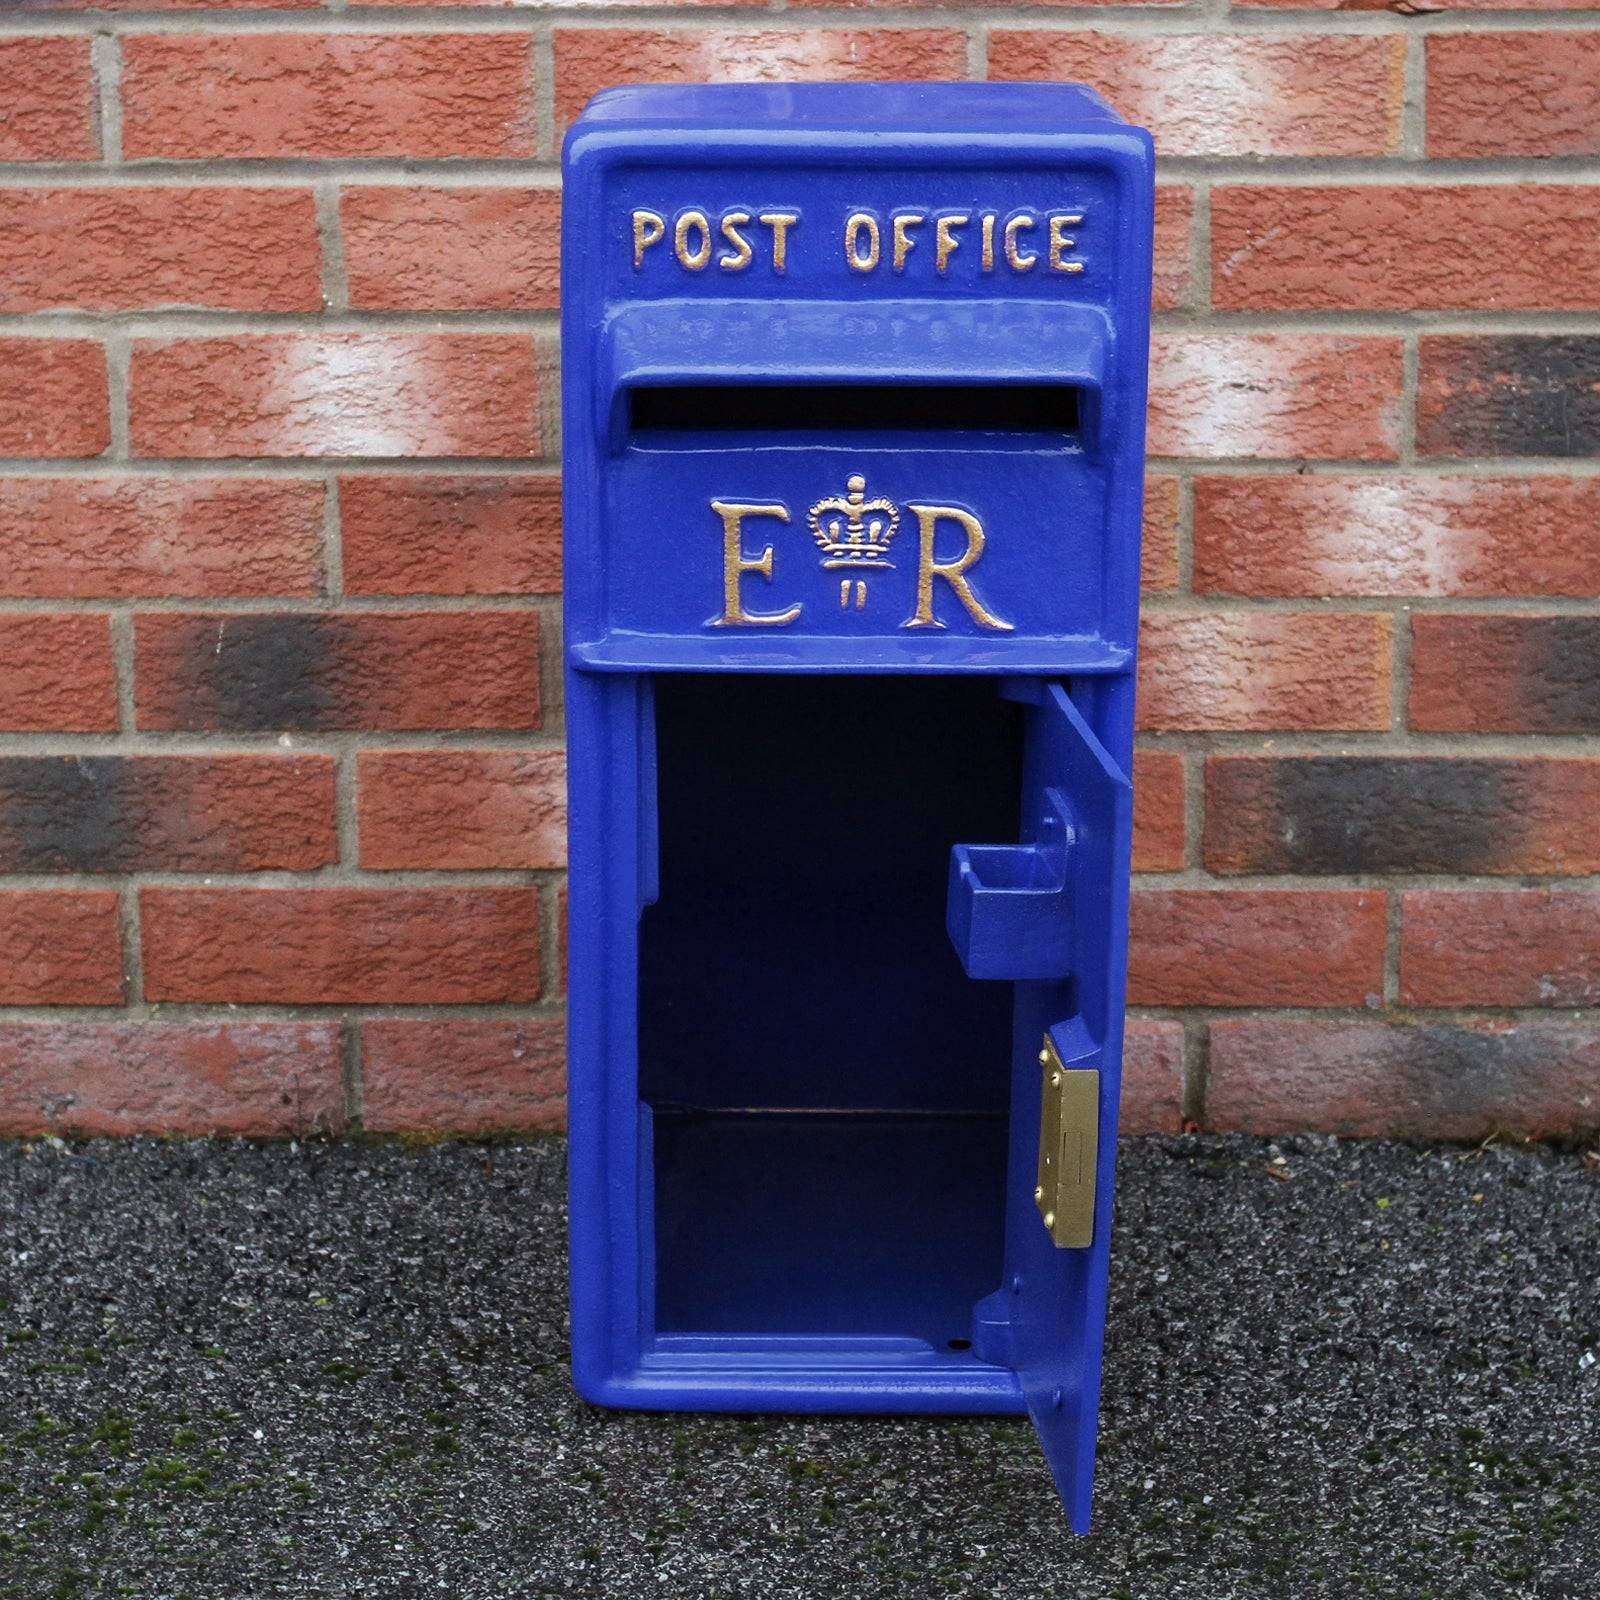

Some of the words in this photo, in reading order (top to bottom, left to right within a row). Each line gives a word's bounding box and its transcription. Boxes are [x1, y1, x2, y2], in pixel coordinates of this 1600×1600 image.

[632, 210, 797, 274] POST
[844, 213, 1085, 274] OFFICE
[705, 499, 802, 627] E
[903, 503, 1014, 630] R
